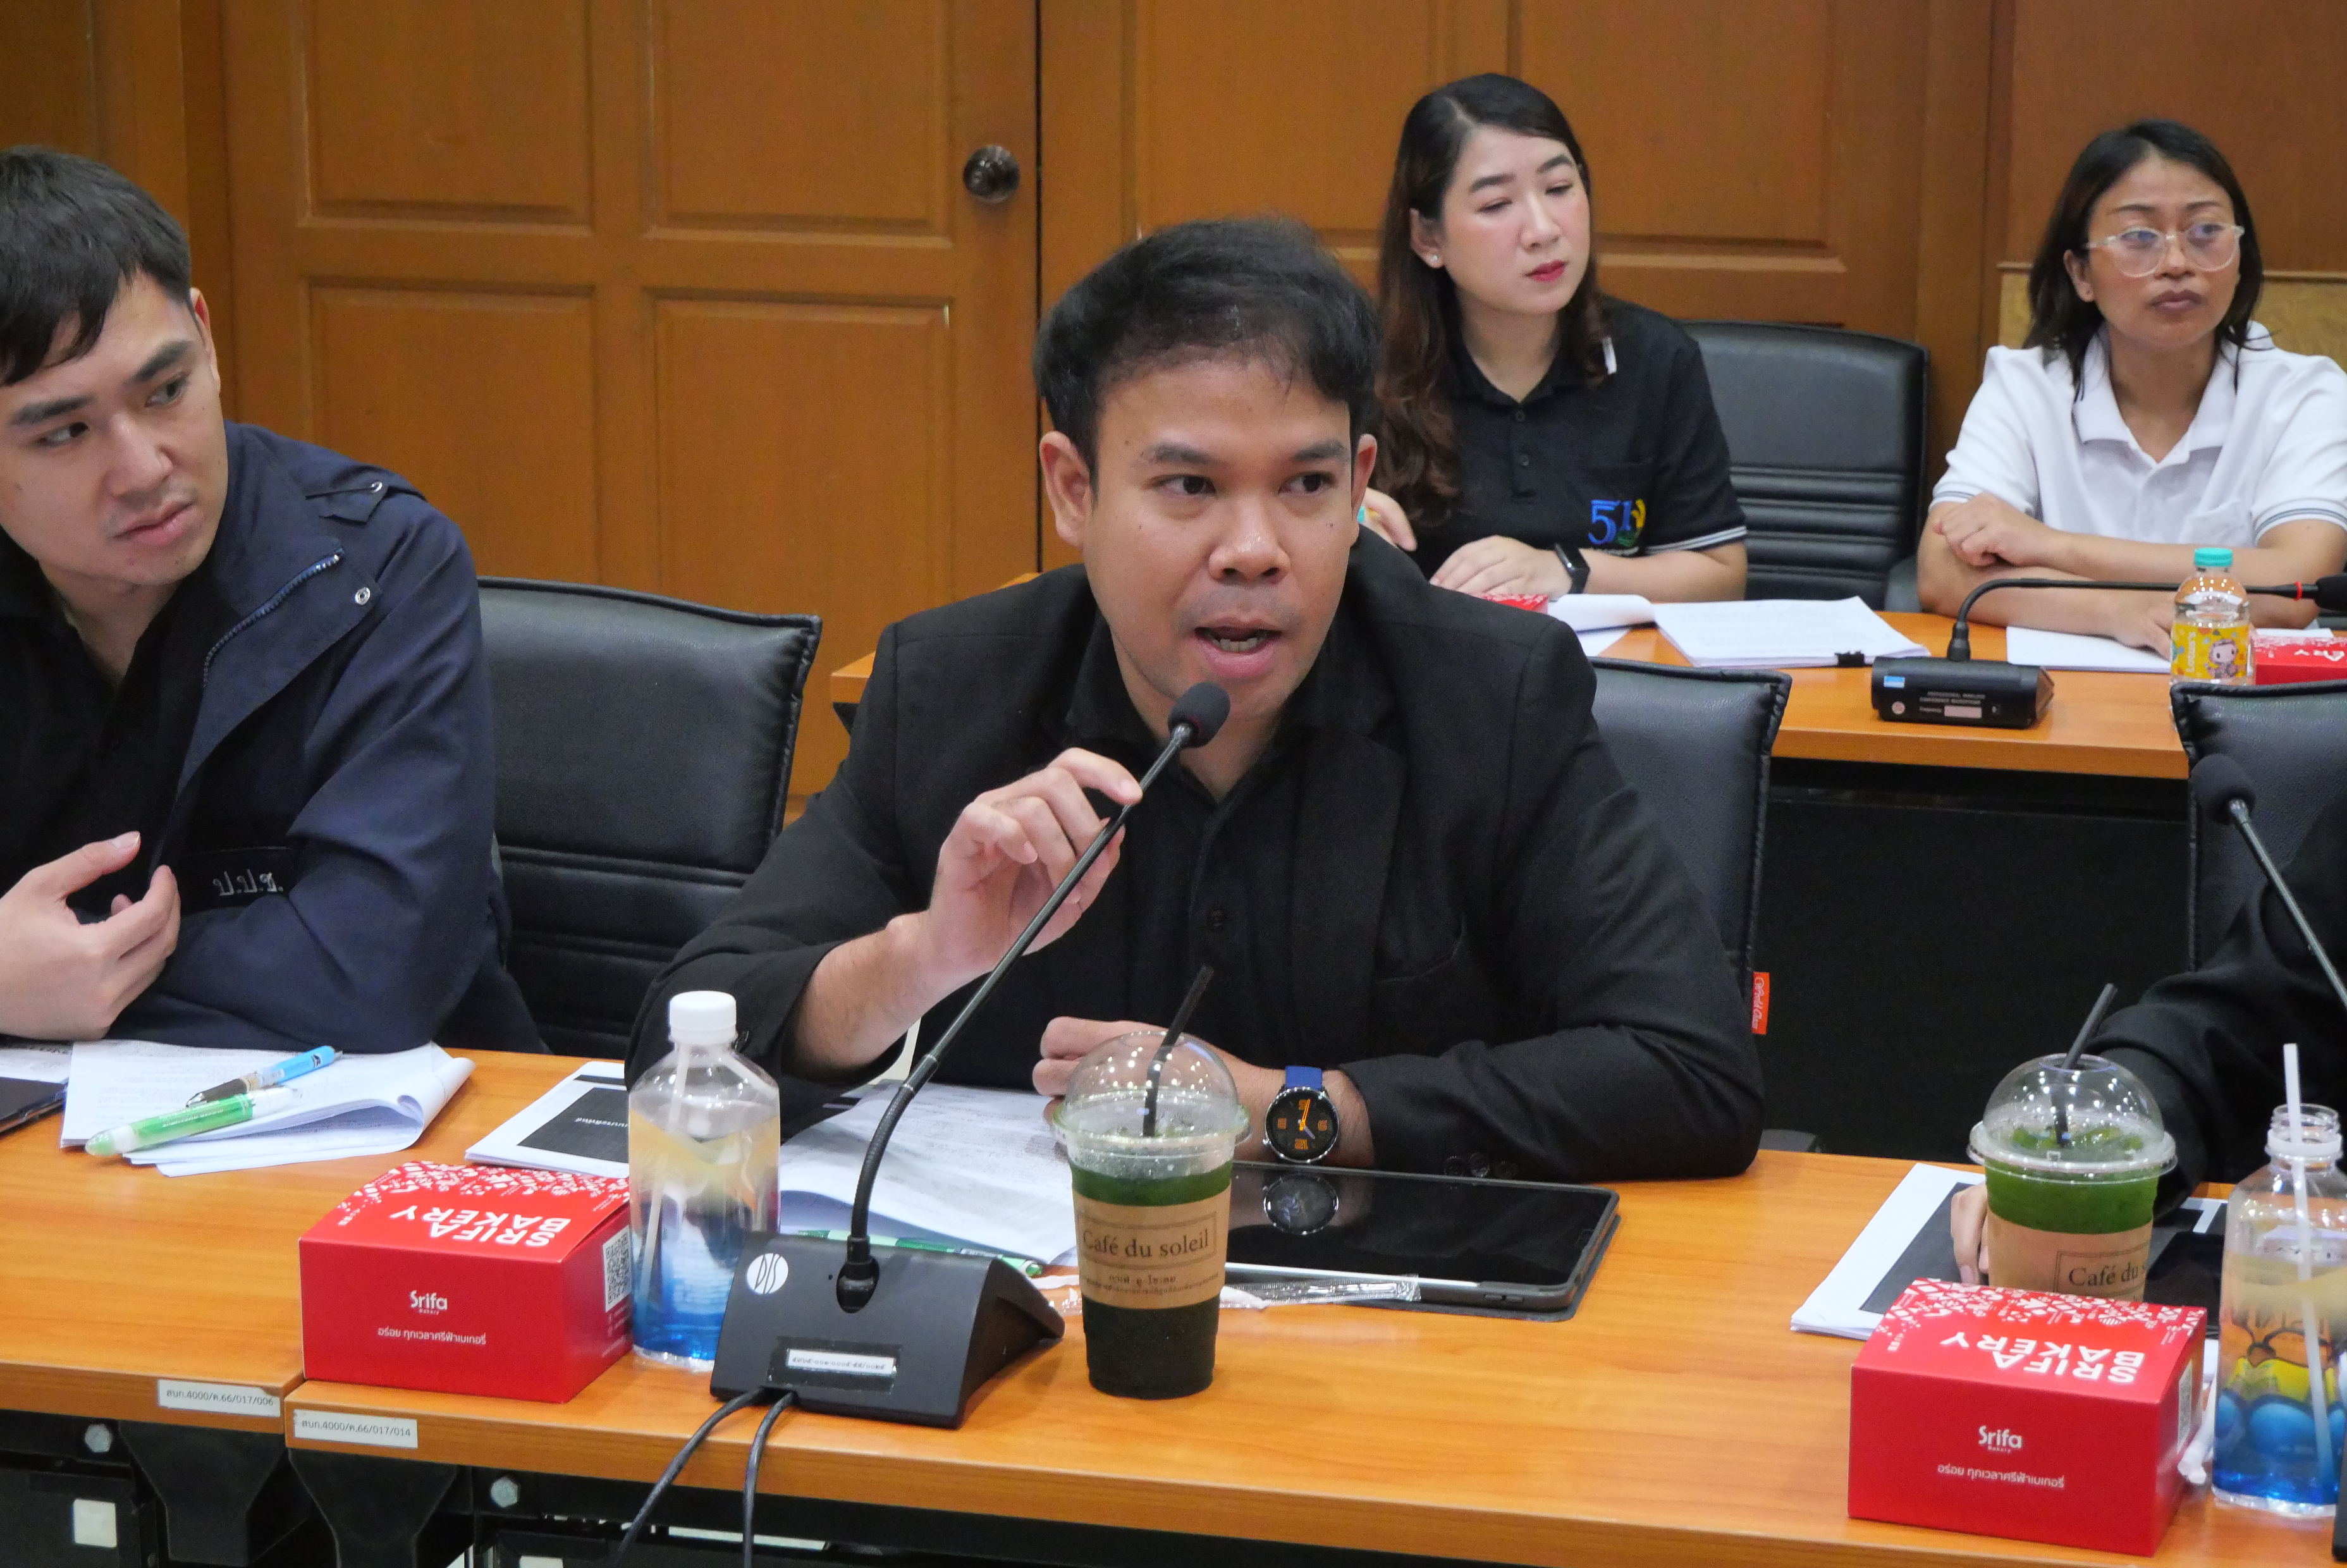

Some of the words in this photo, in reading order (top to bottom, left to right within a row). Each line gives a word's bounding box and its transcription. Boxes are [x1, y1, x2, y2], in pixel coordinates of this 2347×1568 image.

[213, 869, 284, 896] ป.ป.ช.
[389, 1205, 571, 1232] BAKERY
[429, 1222, 555, 1247] SRIFA
[1083, 1230, 1118, 1254] Café
[1125, 1239, 1152, 1258] du
[1160, 1227, 1208, 1256] soleil
[2069, 1265, 2116, 1286] Café
[2121, 1259, 2138, 1282] du
[410, 1290, 448, 1310] Srifa
[377, 1326, 401, 1337] อร่อย
[1940, 1332, 2145, 1367] BAKERY
[1992, 1351, 2137, 1383] SRIFA
[1978, 1425, 2023, 1449] Srifa
[1937, 1463, 1964, 1476] อร่อย
